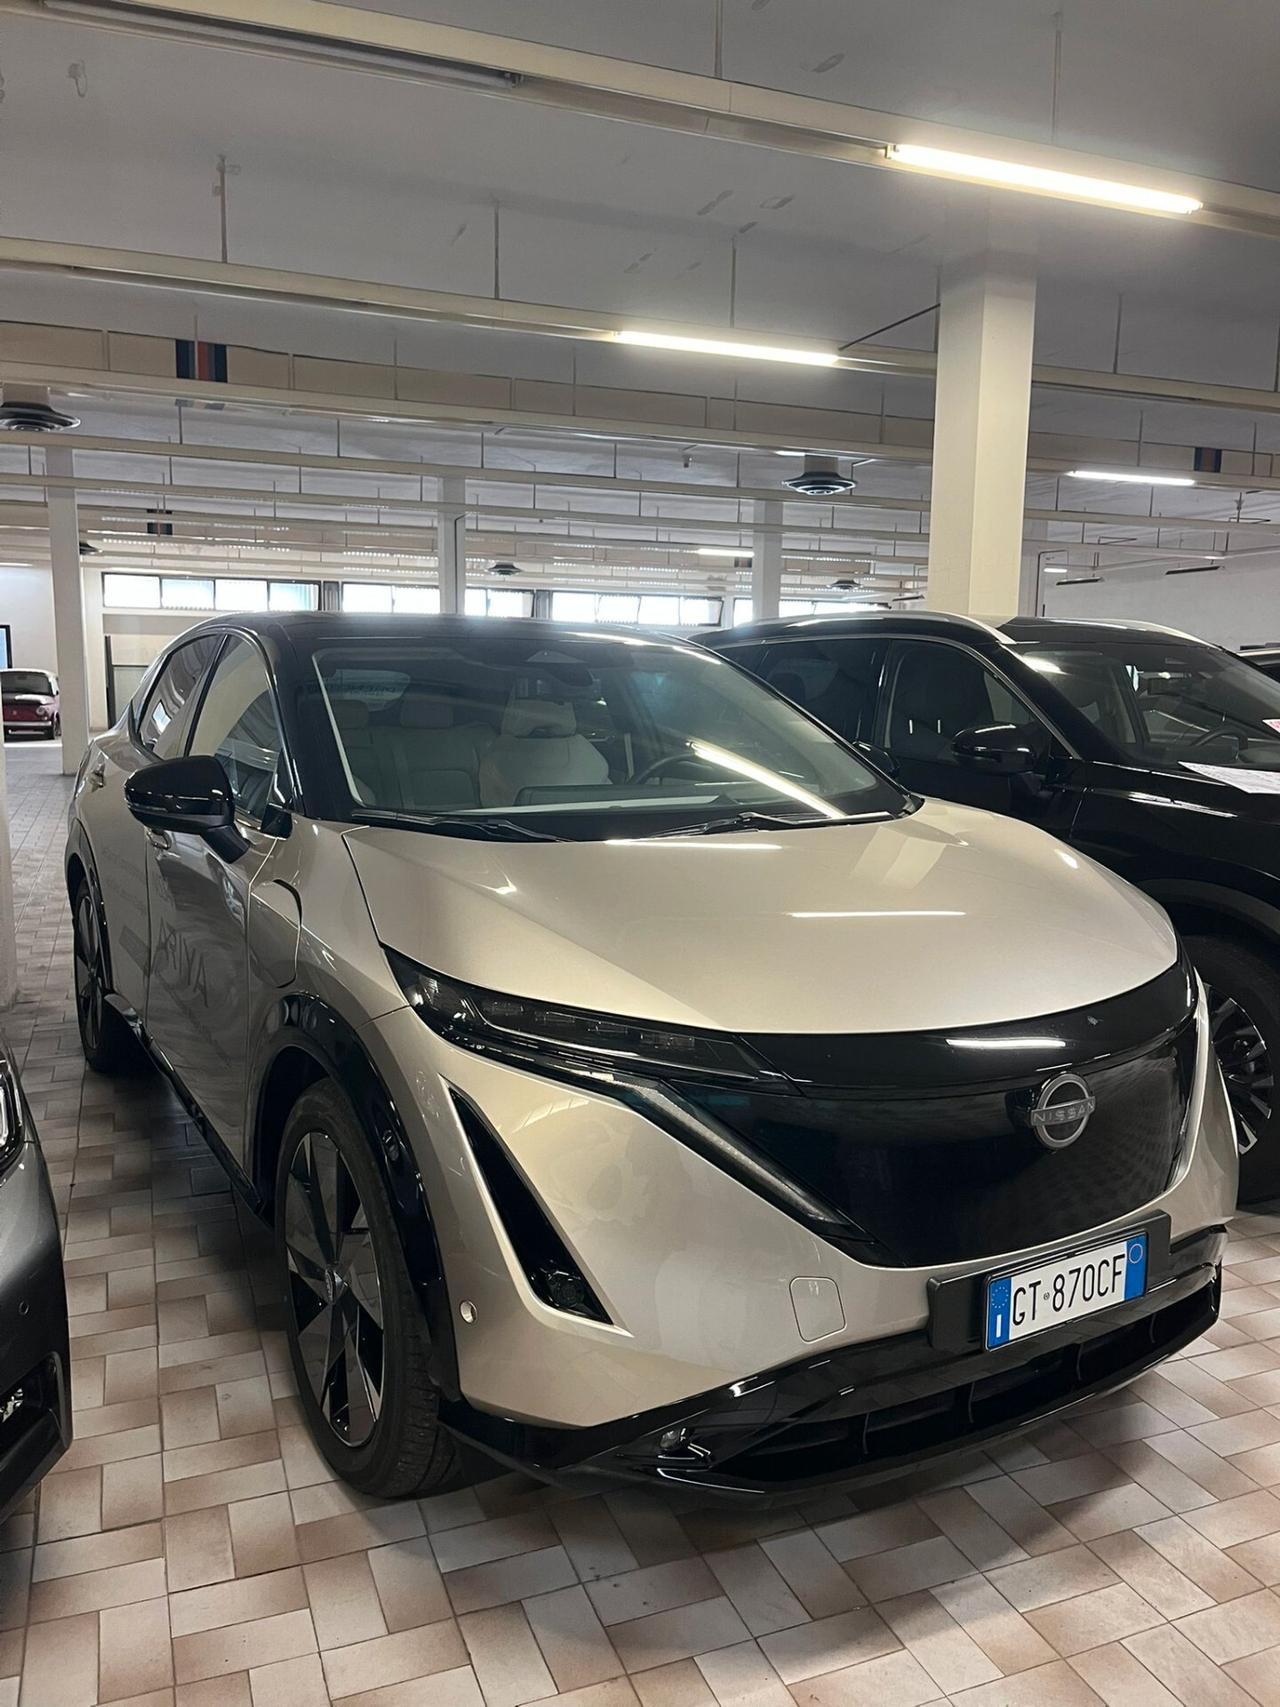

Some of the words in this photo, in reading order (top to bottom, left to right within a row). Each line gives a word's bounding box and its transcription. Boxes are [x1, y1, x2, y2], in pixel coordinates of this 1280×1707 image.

[1034, 1097, 1095, 1122] NISSAN
[1013, 1280, 1042, 1327] GT
[1052, 1254, 1126, 1312] 870CF
